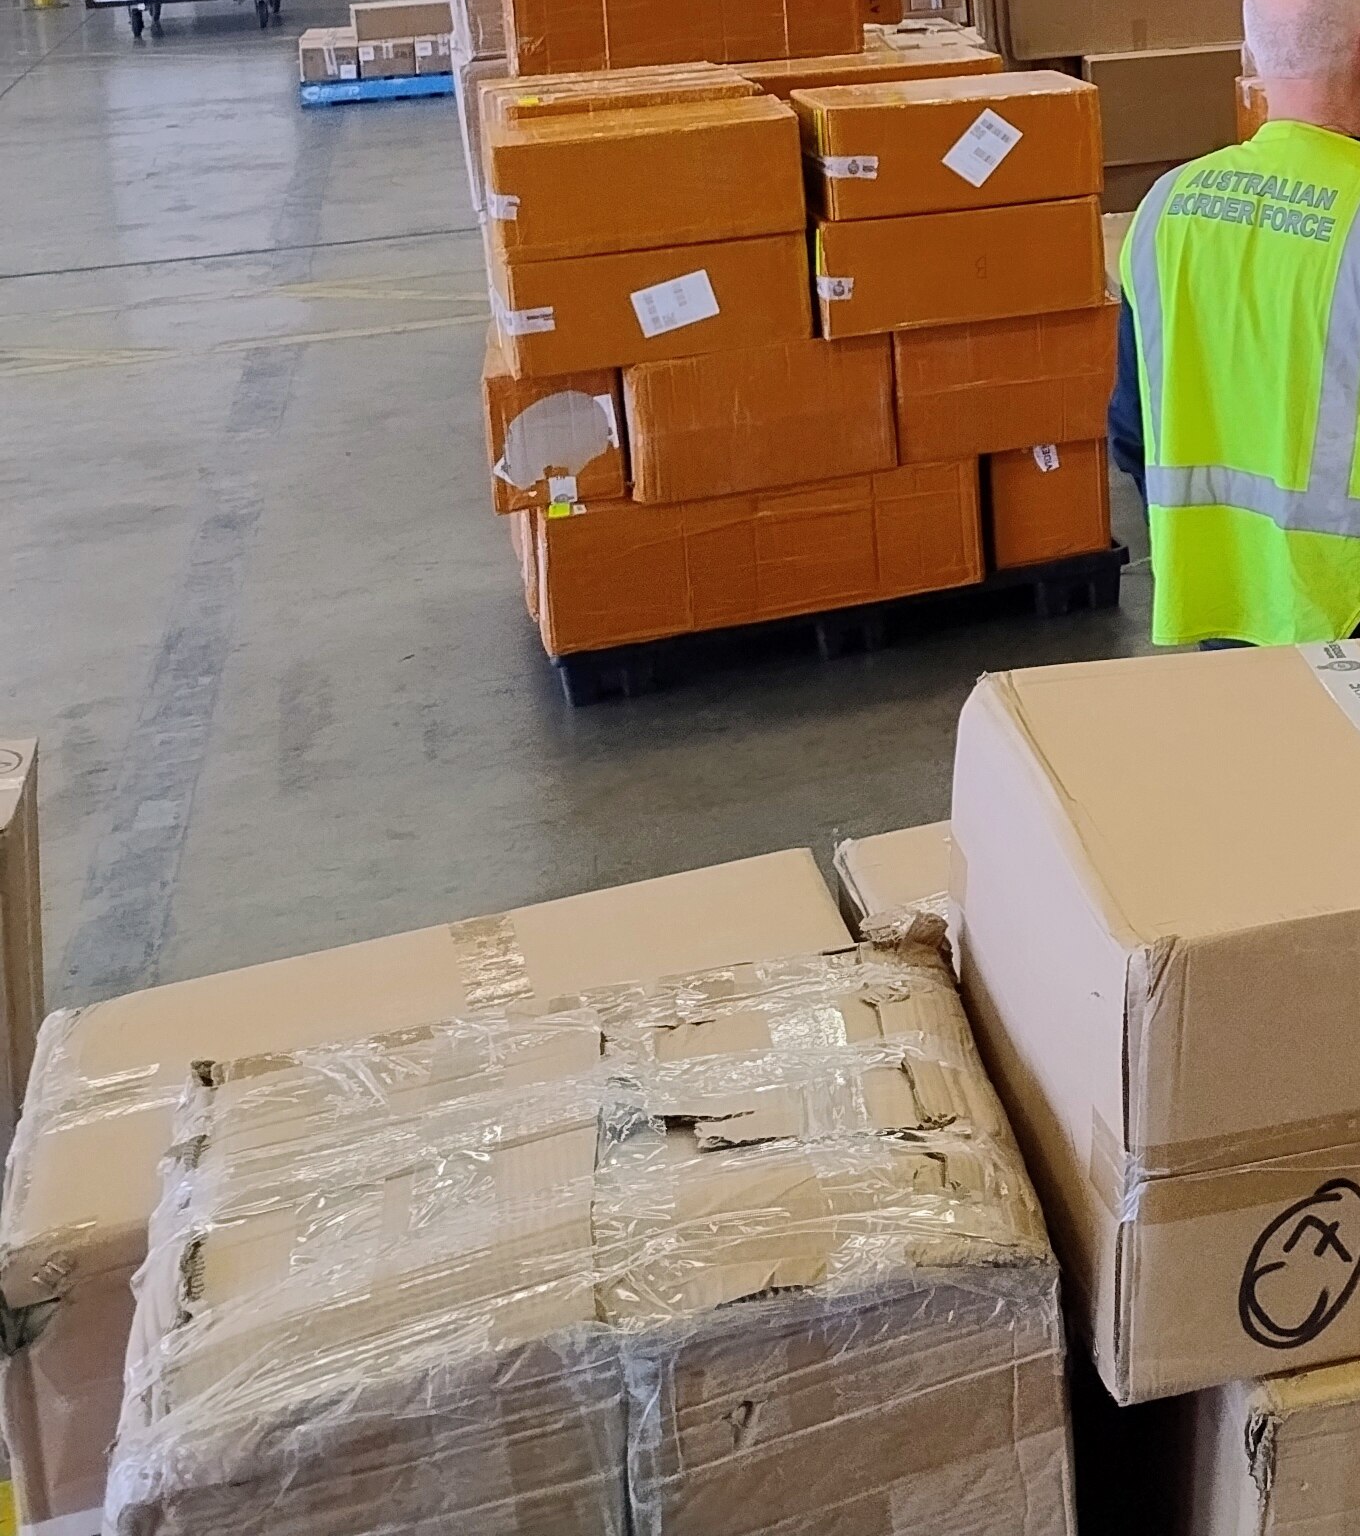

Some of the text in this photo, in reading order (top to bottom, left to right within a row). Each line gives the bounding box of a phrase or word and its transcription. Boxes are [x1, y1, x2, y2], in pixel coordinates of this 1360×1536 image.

[1186, 169, 1339, 211] AUSTRALIAN
[1167, 192, 1336, 243] BORDER FORCE
